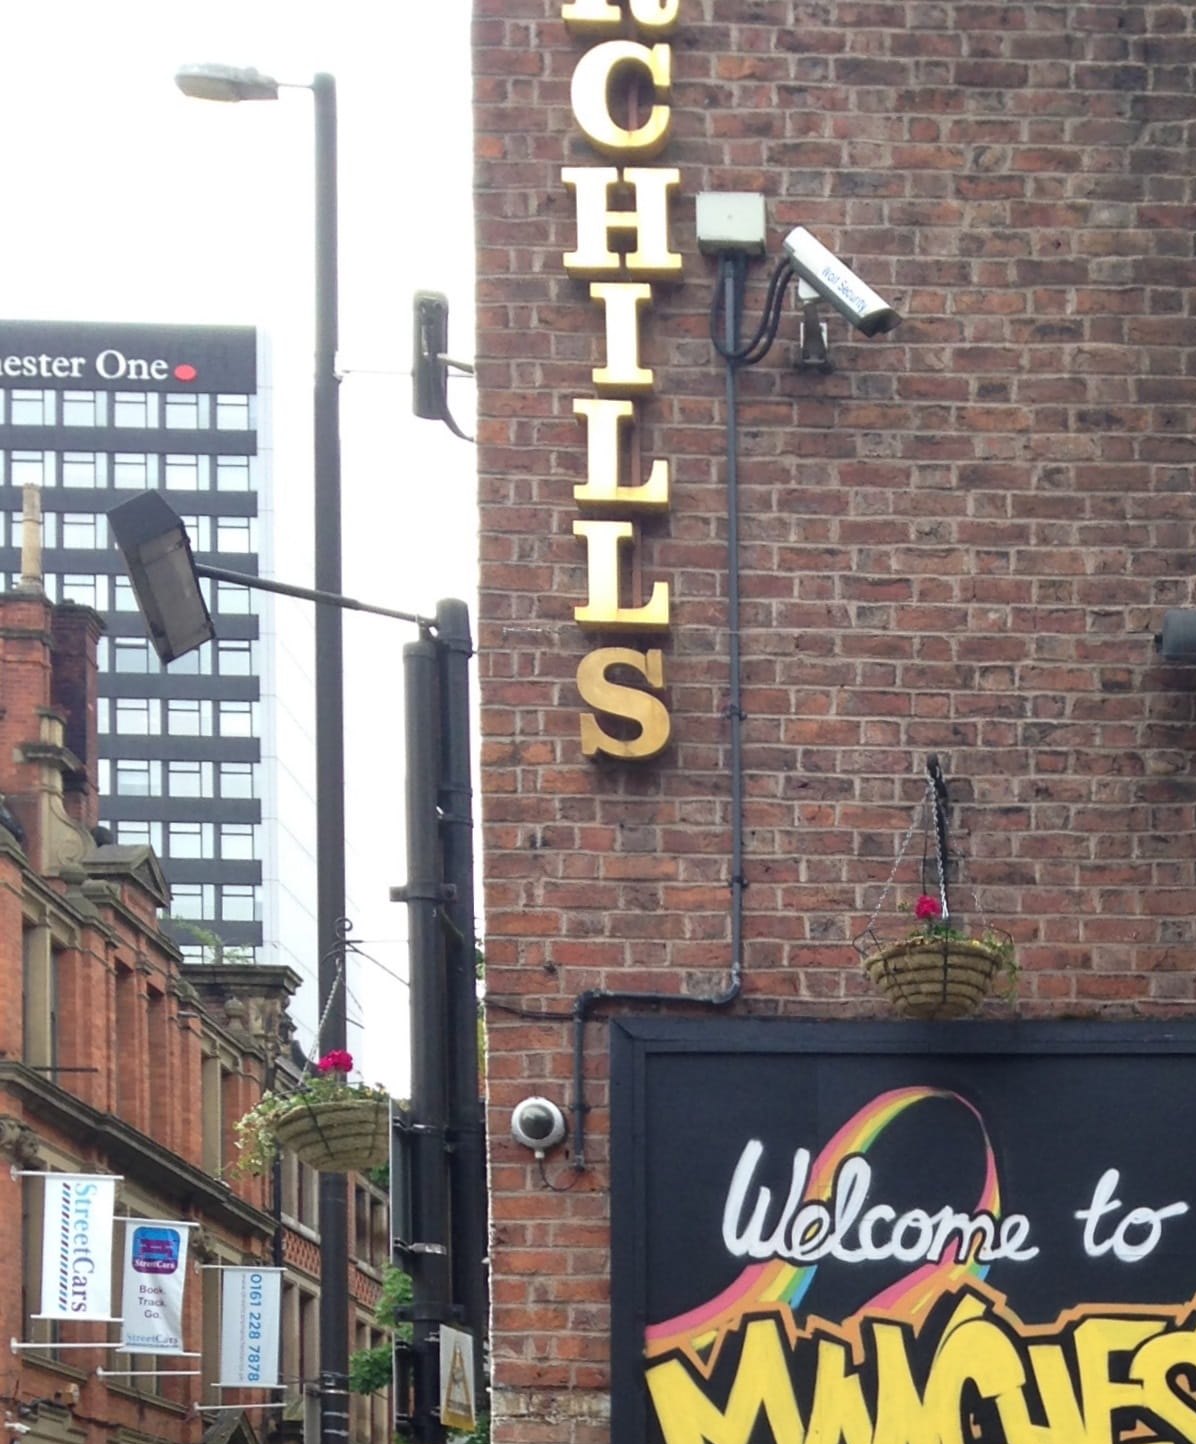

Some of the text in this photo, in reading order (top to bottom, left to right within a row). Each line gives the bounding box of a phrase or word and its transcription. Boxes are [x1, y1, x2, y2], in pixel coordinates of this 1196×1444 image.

[0, 349, 168, 379] ester One
[562, 0, 684, 760] CHILLS
[71, 1182, 98, 1312] StreetCars
[722, 1139, 1189, 1263] Welcome to
[134, 1259, 176, 1269] StreetCars
[247, 1273, 263, 1382] 0161 228 7878
